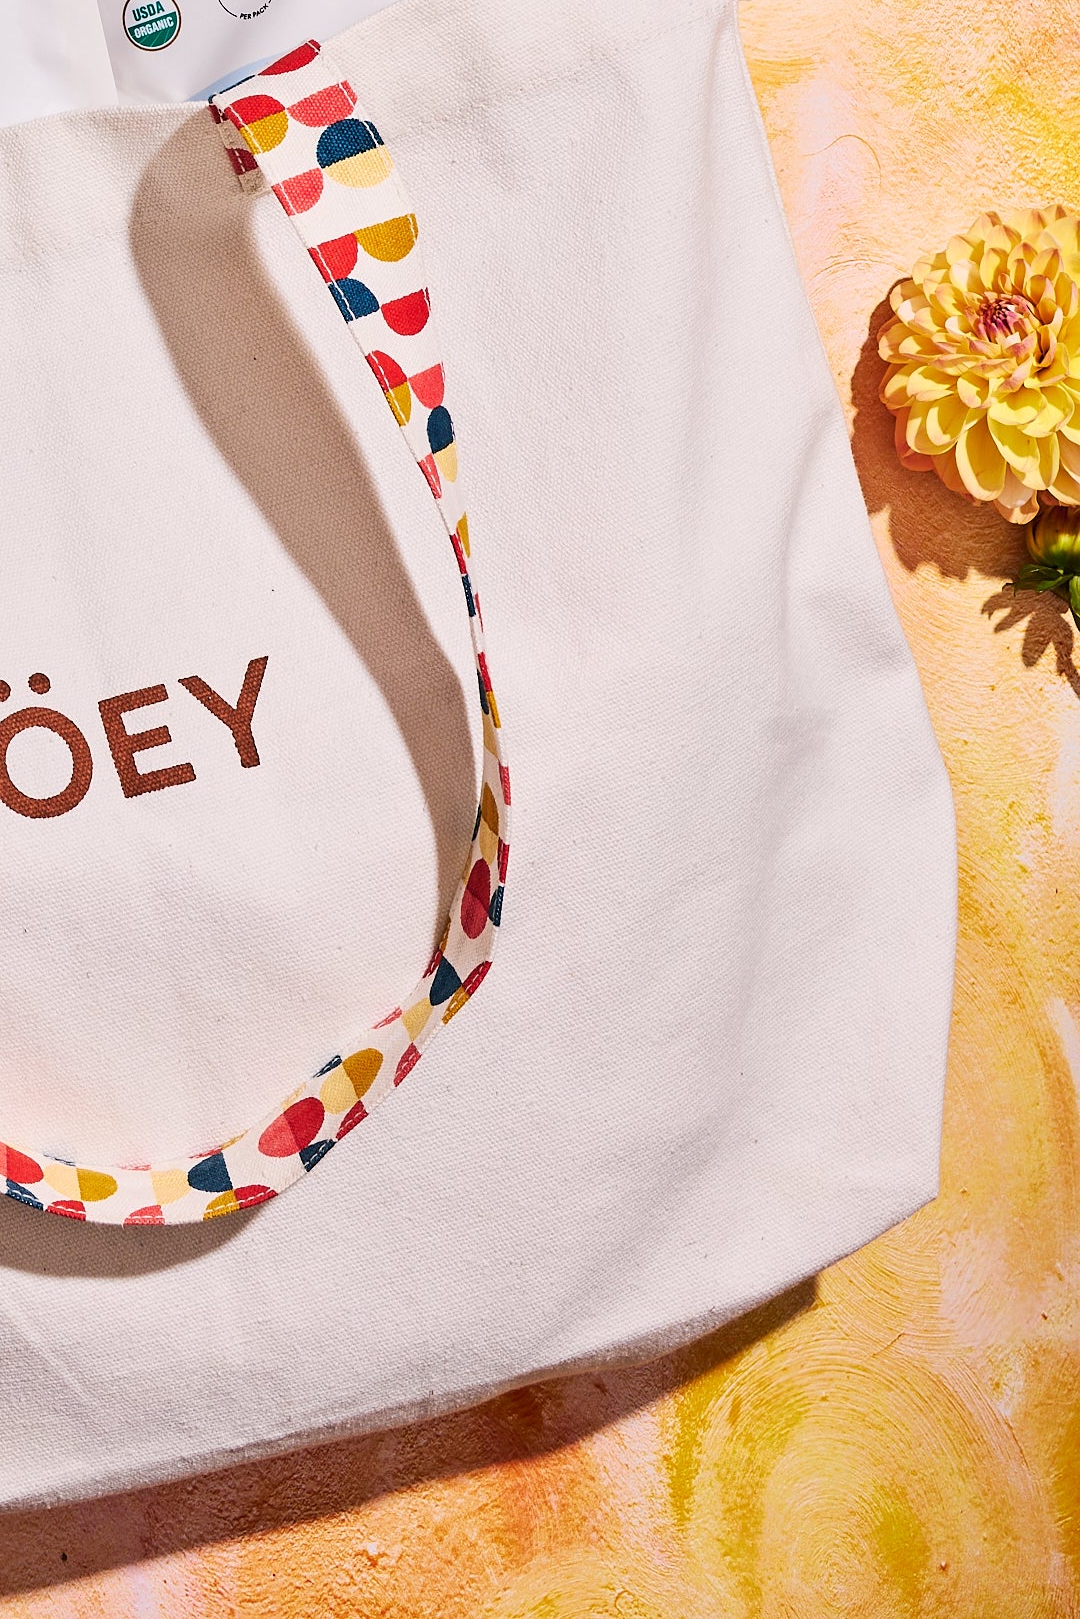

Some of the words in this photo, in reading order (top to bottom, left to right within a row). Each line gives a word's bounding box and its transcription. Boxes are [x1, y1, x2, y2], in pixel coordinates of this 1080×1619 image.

[132, 0, 165, 22] USDA
[239, 12, 252, 20] PER
[253, 3, 269, 17] PACK
[134, 16, 174, 39] ORGANIC
